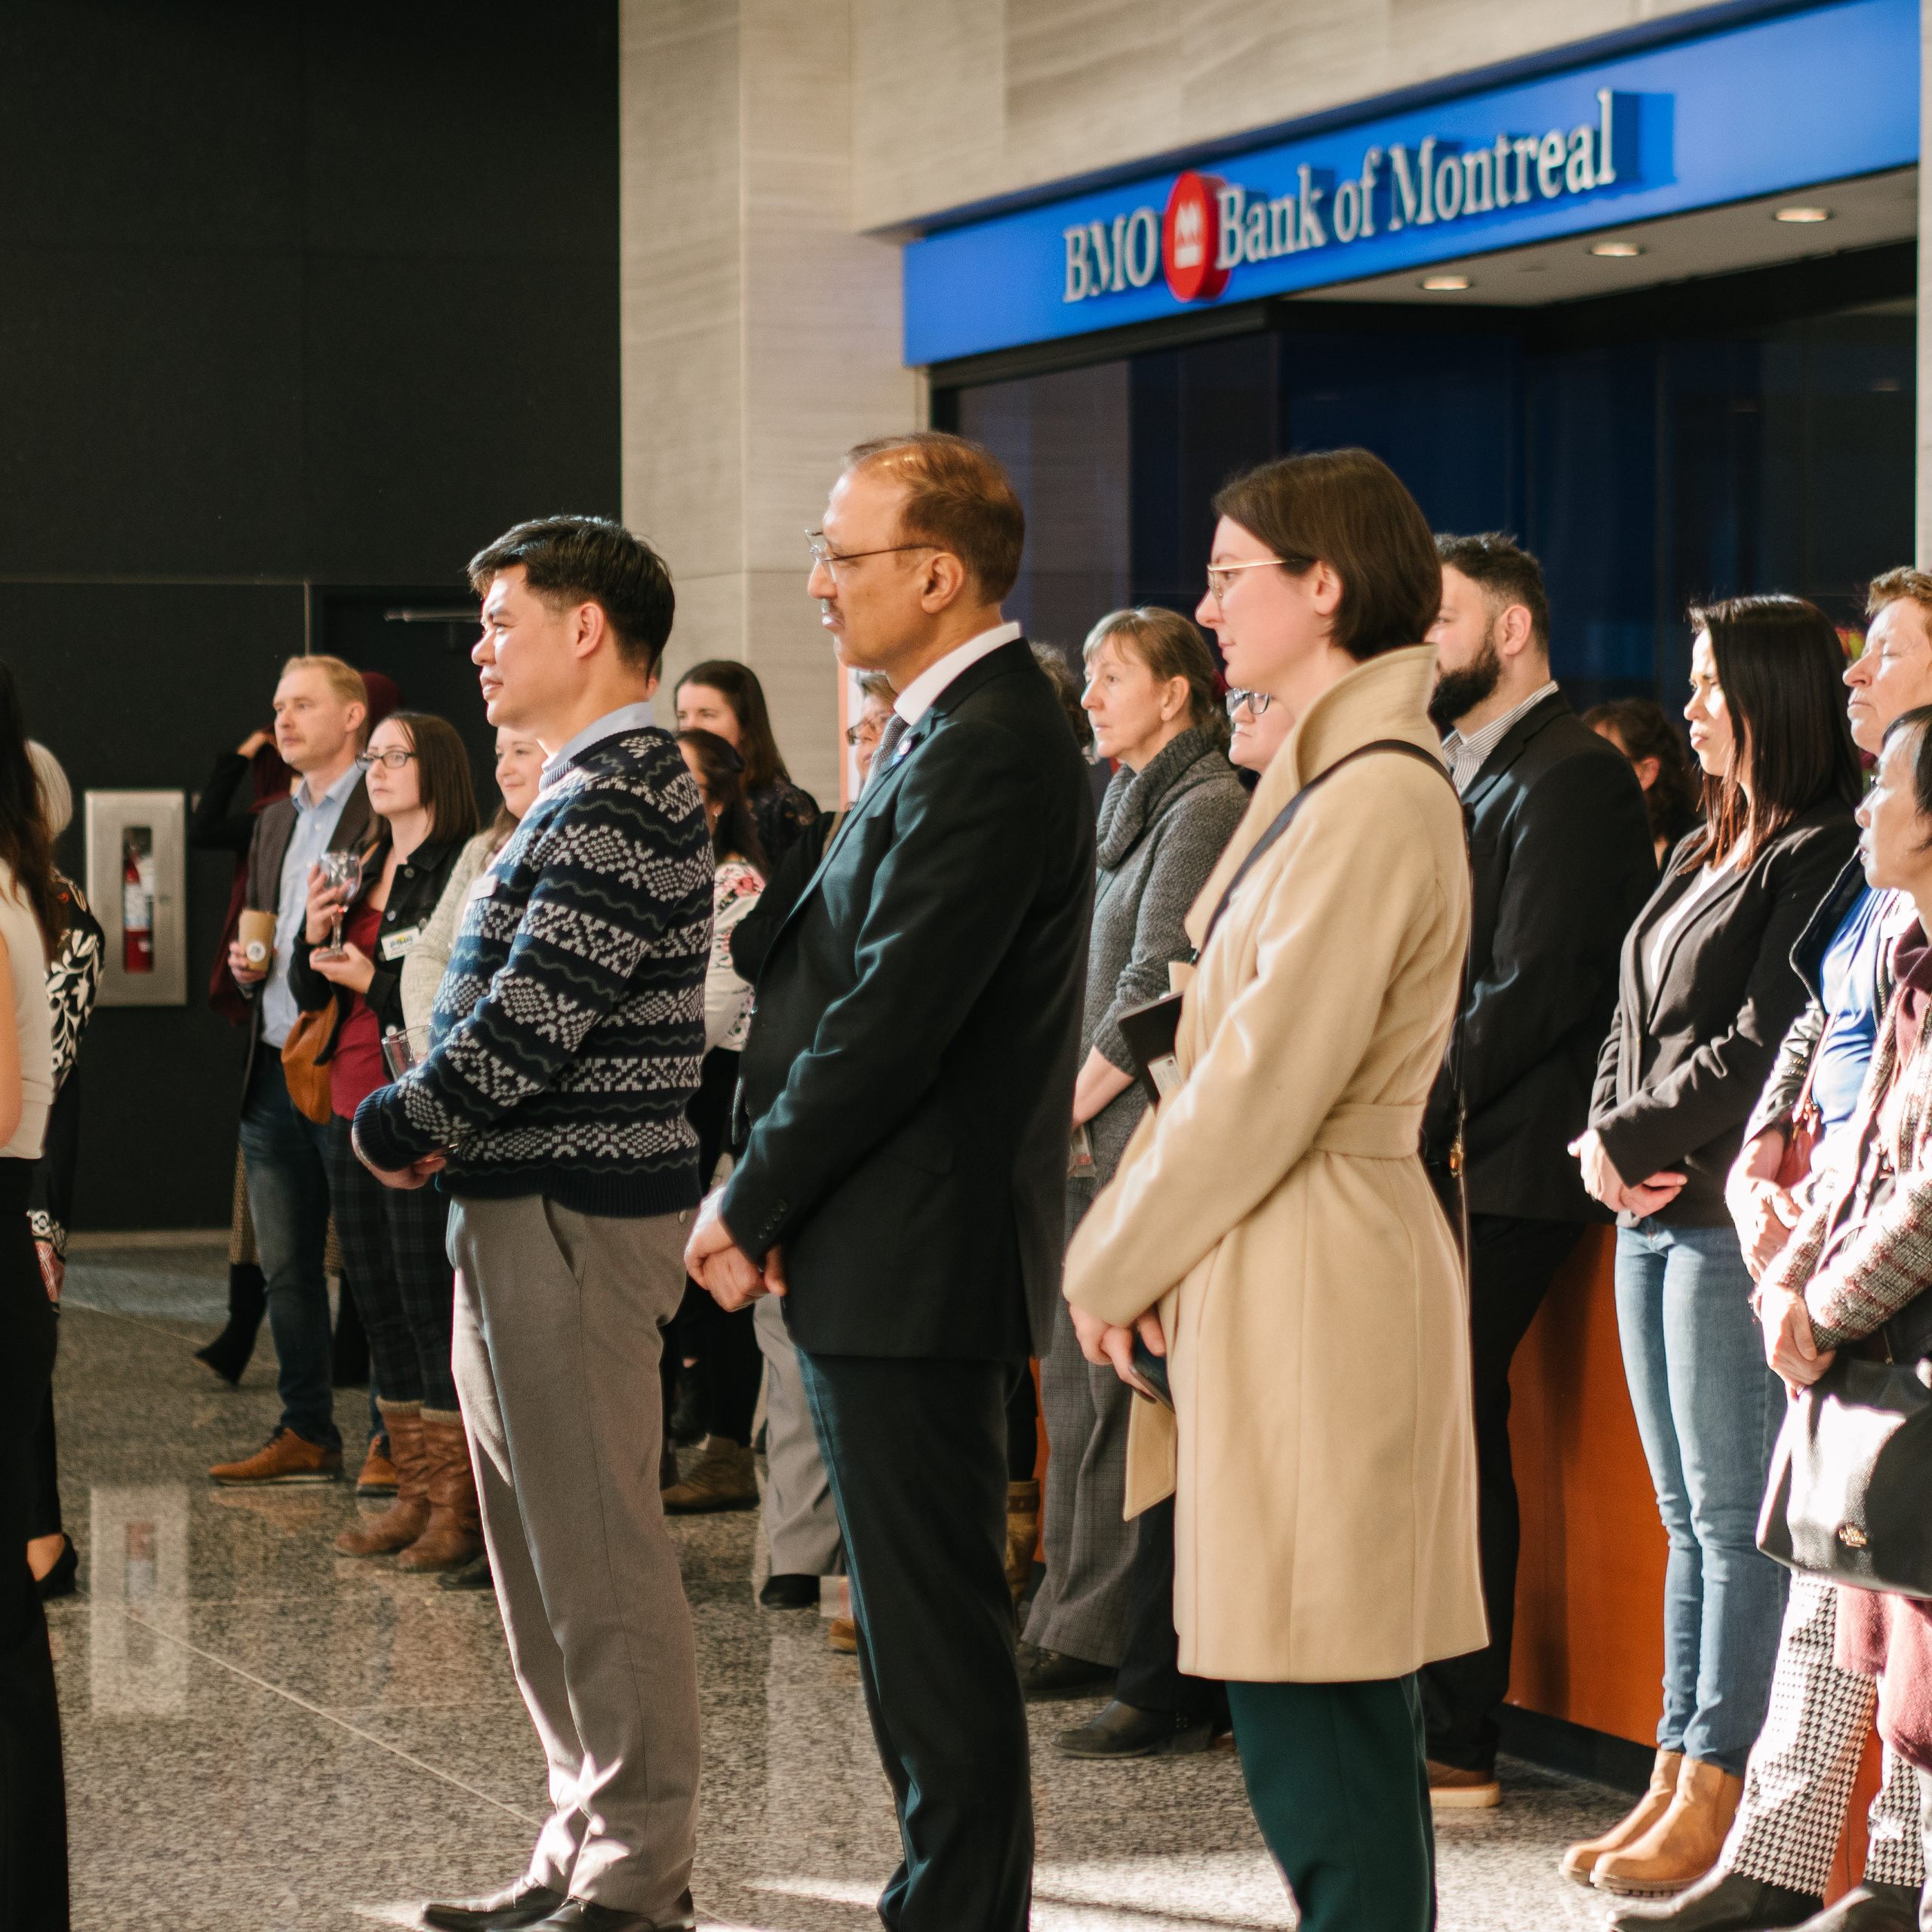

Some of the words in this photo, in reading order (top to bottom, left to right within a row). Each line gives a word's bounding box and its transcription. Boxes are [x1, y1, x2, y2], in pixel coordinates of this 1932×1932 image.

[1064, 209, 1158, 302] BMO
[1217, 165, 1326, 270] Bank
[1333, 147, 1382, 242] of
[1389, 88, 1616, 231] Montreal
